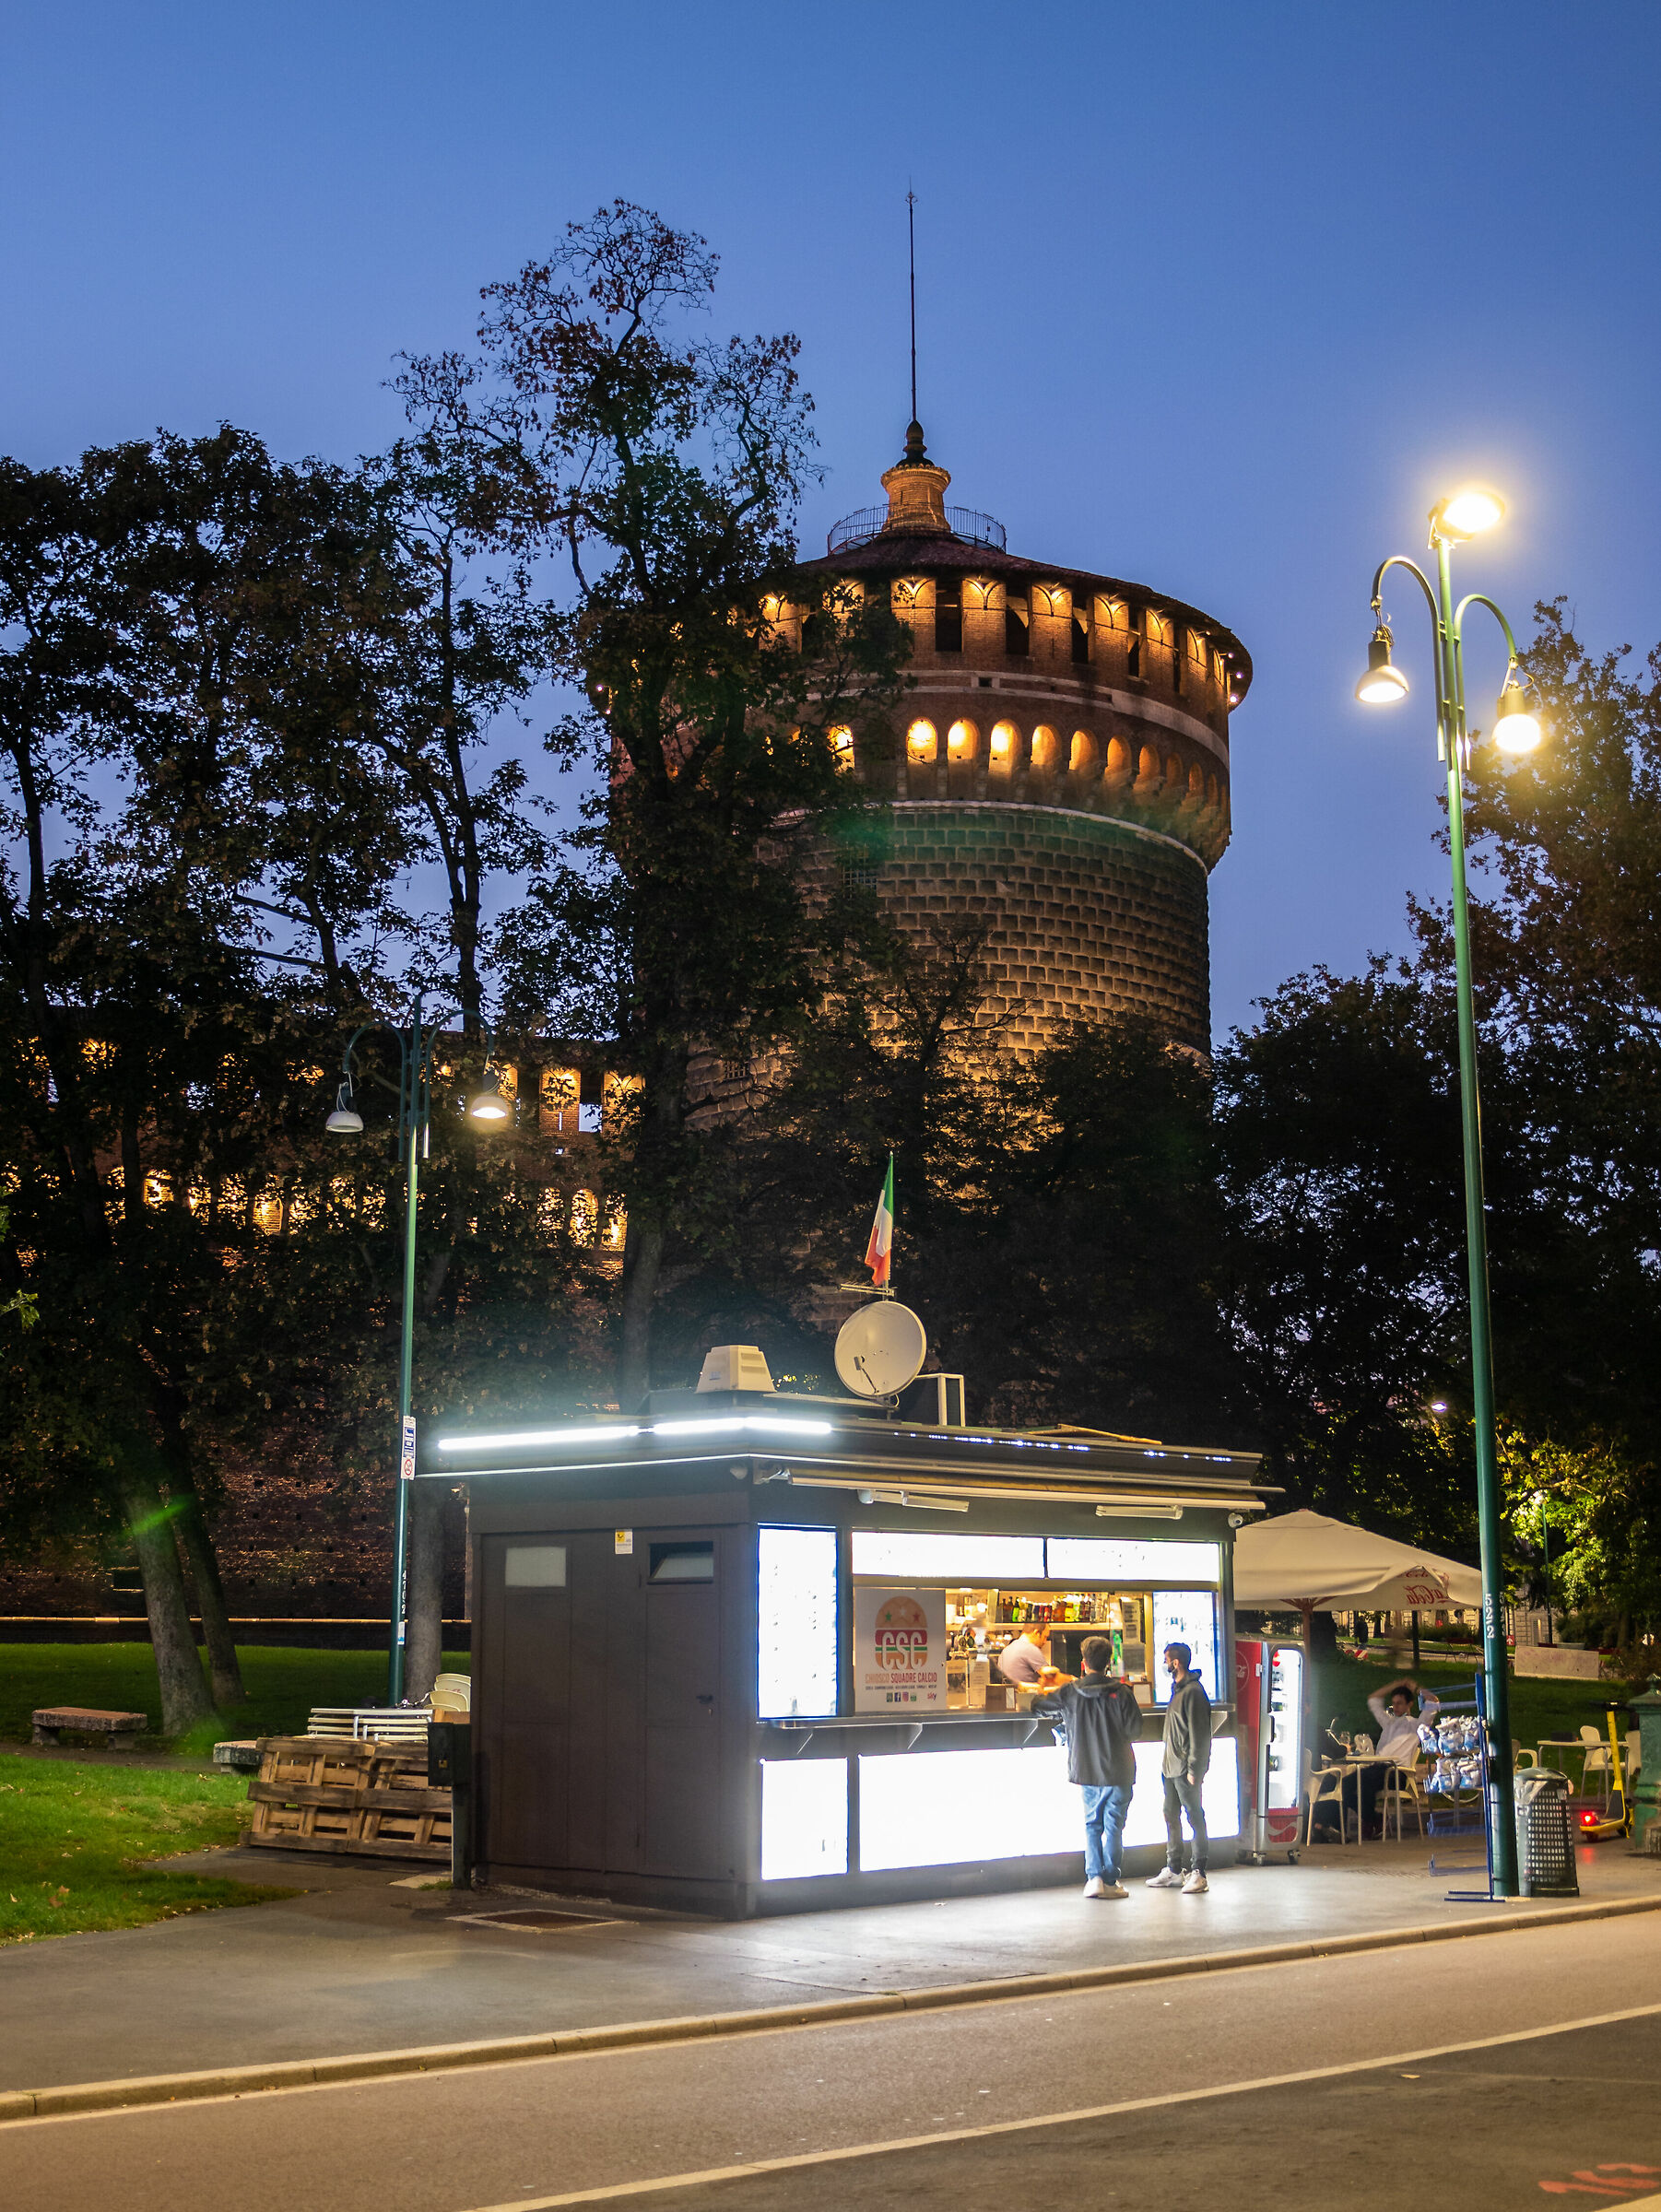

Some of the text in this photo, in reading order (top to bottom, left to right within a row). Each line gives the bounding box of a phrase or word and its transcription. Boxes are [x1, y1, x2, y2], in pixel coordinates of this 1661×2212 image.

[882, 1631, 923, 1672] CSC
[866, 1672, 937, 1683] CHIOSCO SQUADRE CALCIO
[927, 1691, 937, 1700] sky
